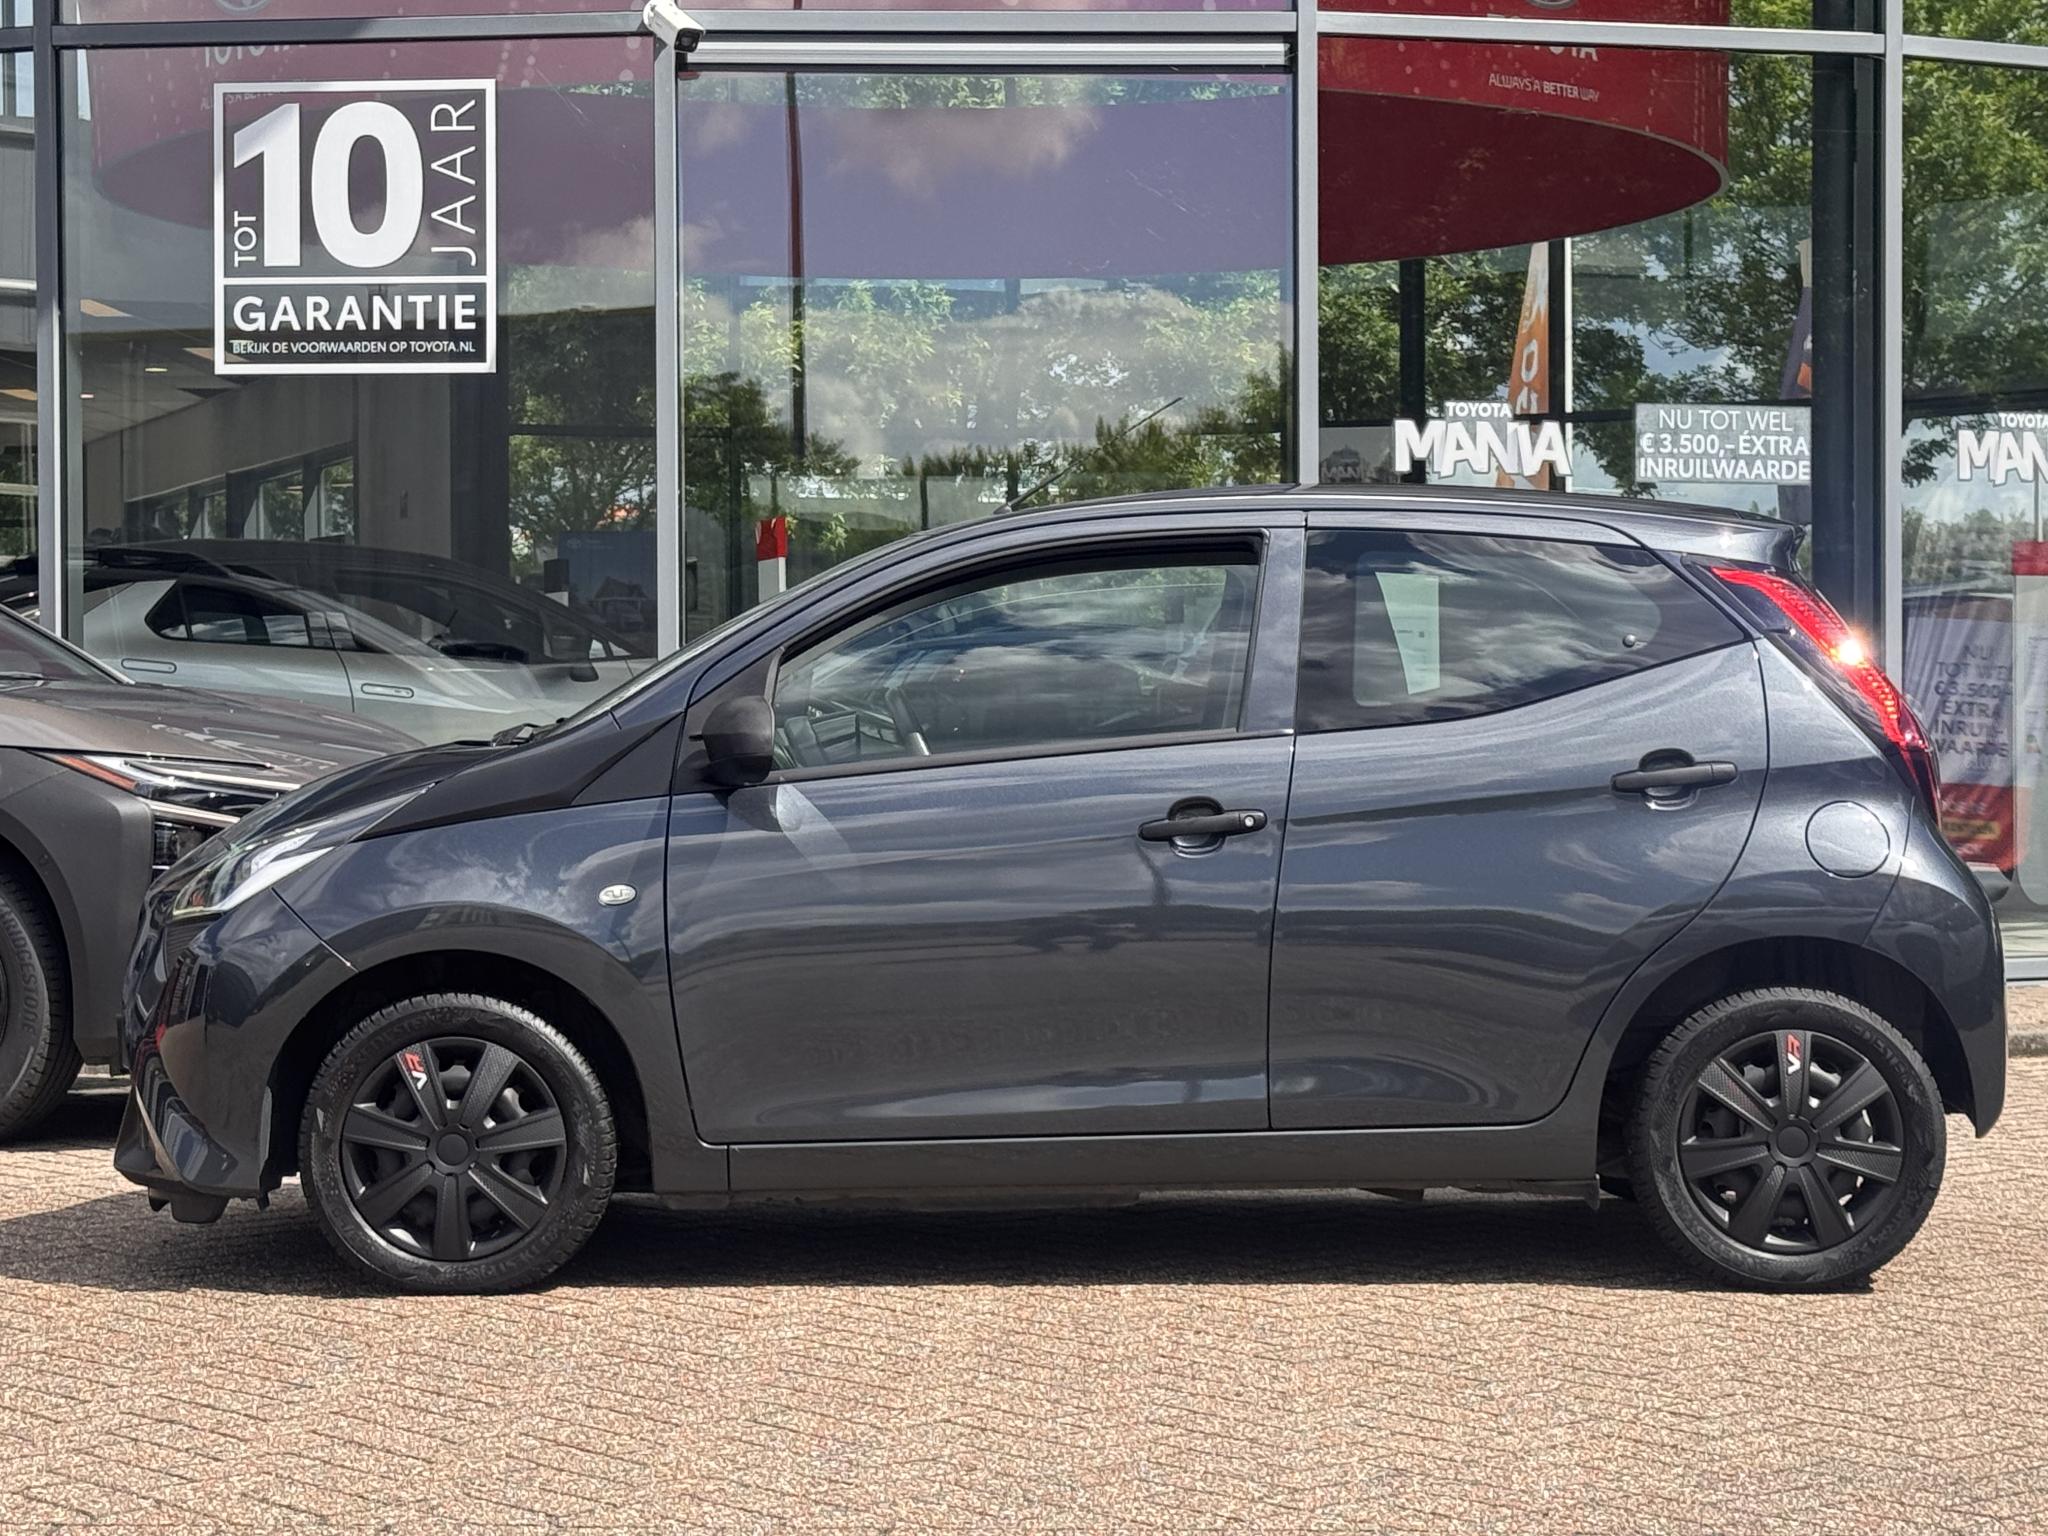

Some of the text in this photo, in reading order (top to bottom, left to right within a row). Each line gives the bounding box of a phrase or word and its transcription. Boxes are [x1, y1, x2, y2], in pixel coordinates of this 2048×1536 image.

[1488, 73, 1532, 92] ALWAYS
[1533, 80, 1542, 93] A
[1543, 81, 1579, 99] BETTER
[233, 101, 424, 268] 10
[431, 99, 477, 267] JAAR
[233, 211, 257, 268] TOT
[232, 294, 477, 333] GARANTIE
[232, 341, 476, 354] BEKIJK DE VOORWAARDEN OP TOYOTA.NL
[1445, 401, 1513, 419] TOYOTA
[1658, 408, 1794, 432] NU TOT WEL
[1394, 419, 1574, 479] MANIA
[1659, 433, 1736, 458] 3.500,-
[1639, 457, 1811, 481] INRUILWAARDE
